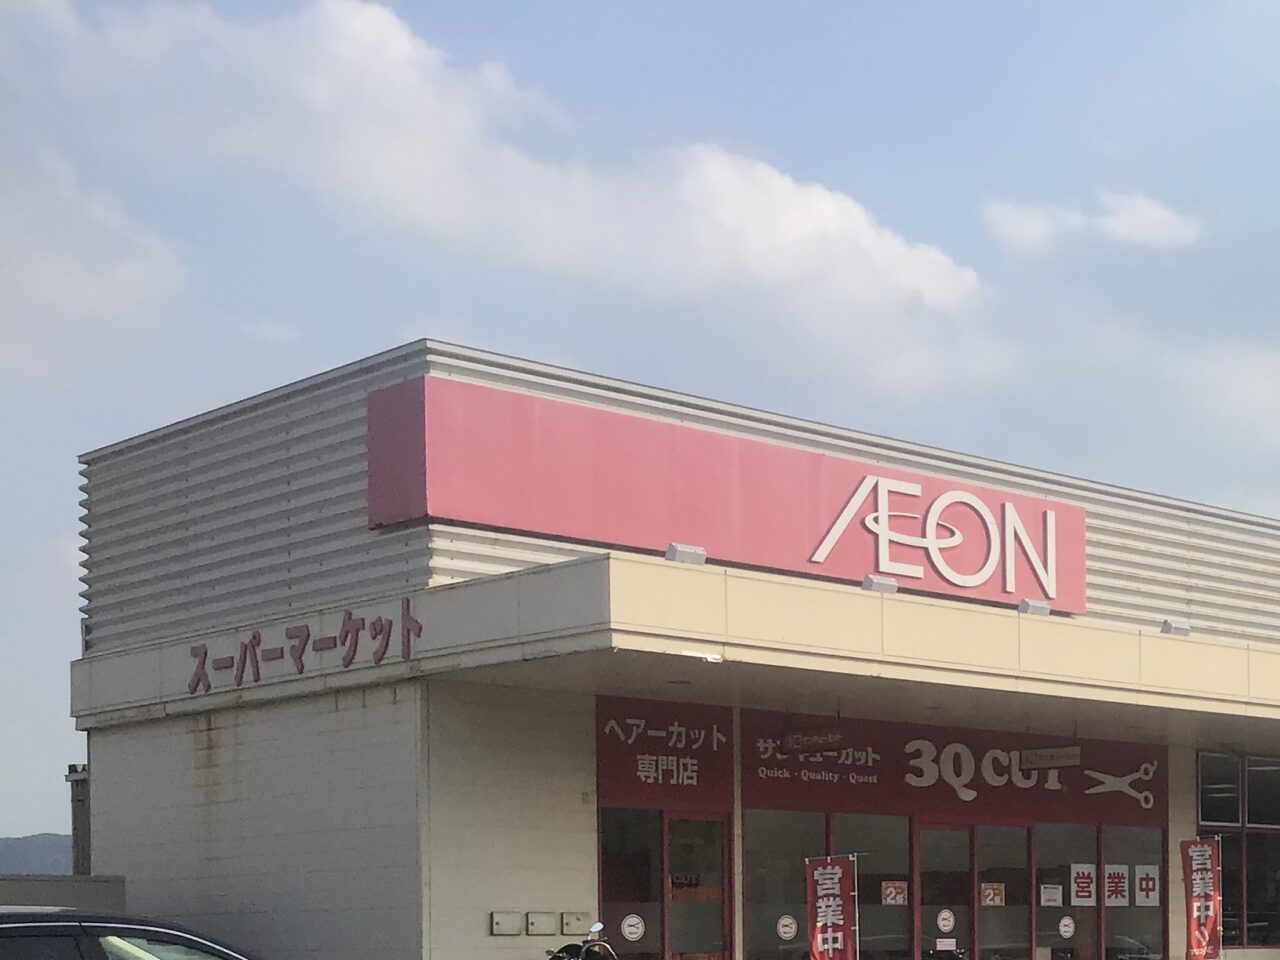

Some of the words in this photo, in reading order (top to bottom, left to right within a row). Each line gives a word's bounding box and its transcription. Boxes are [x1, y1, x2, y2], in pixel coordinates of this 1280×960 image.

[188, 597, 423, 695] スーパーマーケット
[603, 718, 727, 751] ヘアーカット
[636, 754, 698, 786] 専門店
[757, 766, 791, 779] Quick
[800, 769, 839, 784] Quality
[849, 772, 878, 784] Quest
[904, 739, 977, 801] 3Q
